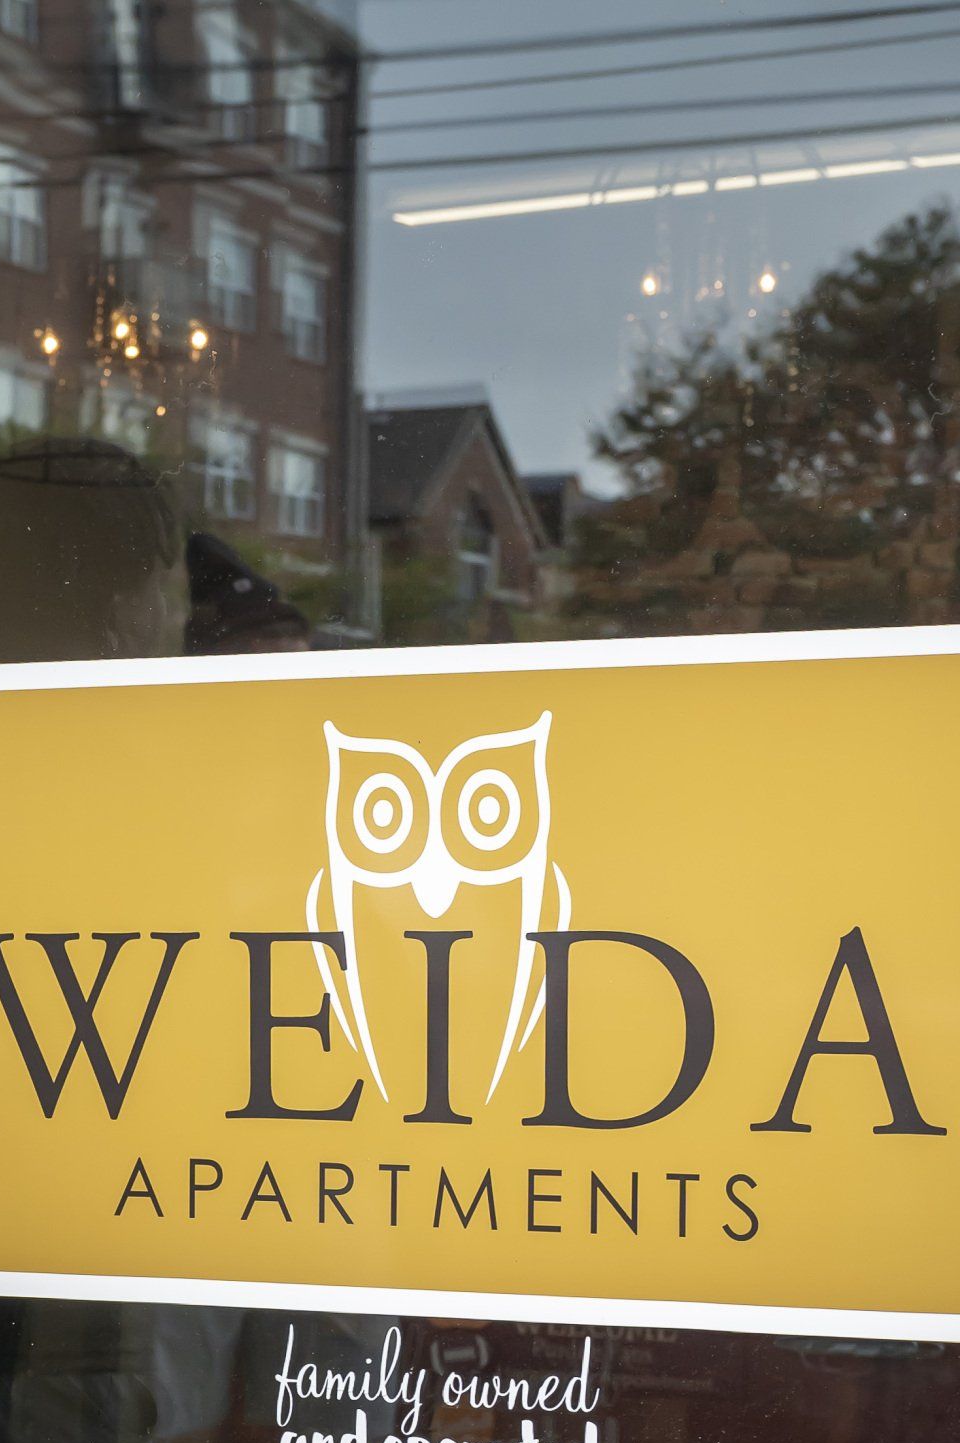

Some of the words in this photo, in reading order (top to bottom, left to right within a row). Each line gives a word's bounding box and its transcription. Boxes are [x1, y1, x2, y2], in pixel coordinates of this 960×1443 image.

[114, 1157, 760, 1242] APARTMENTS
[275, 1324, 426, 1435] family
[442, 1336, 600, 1413] owned
